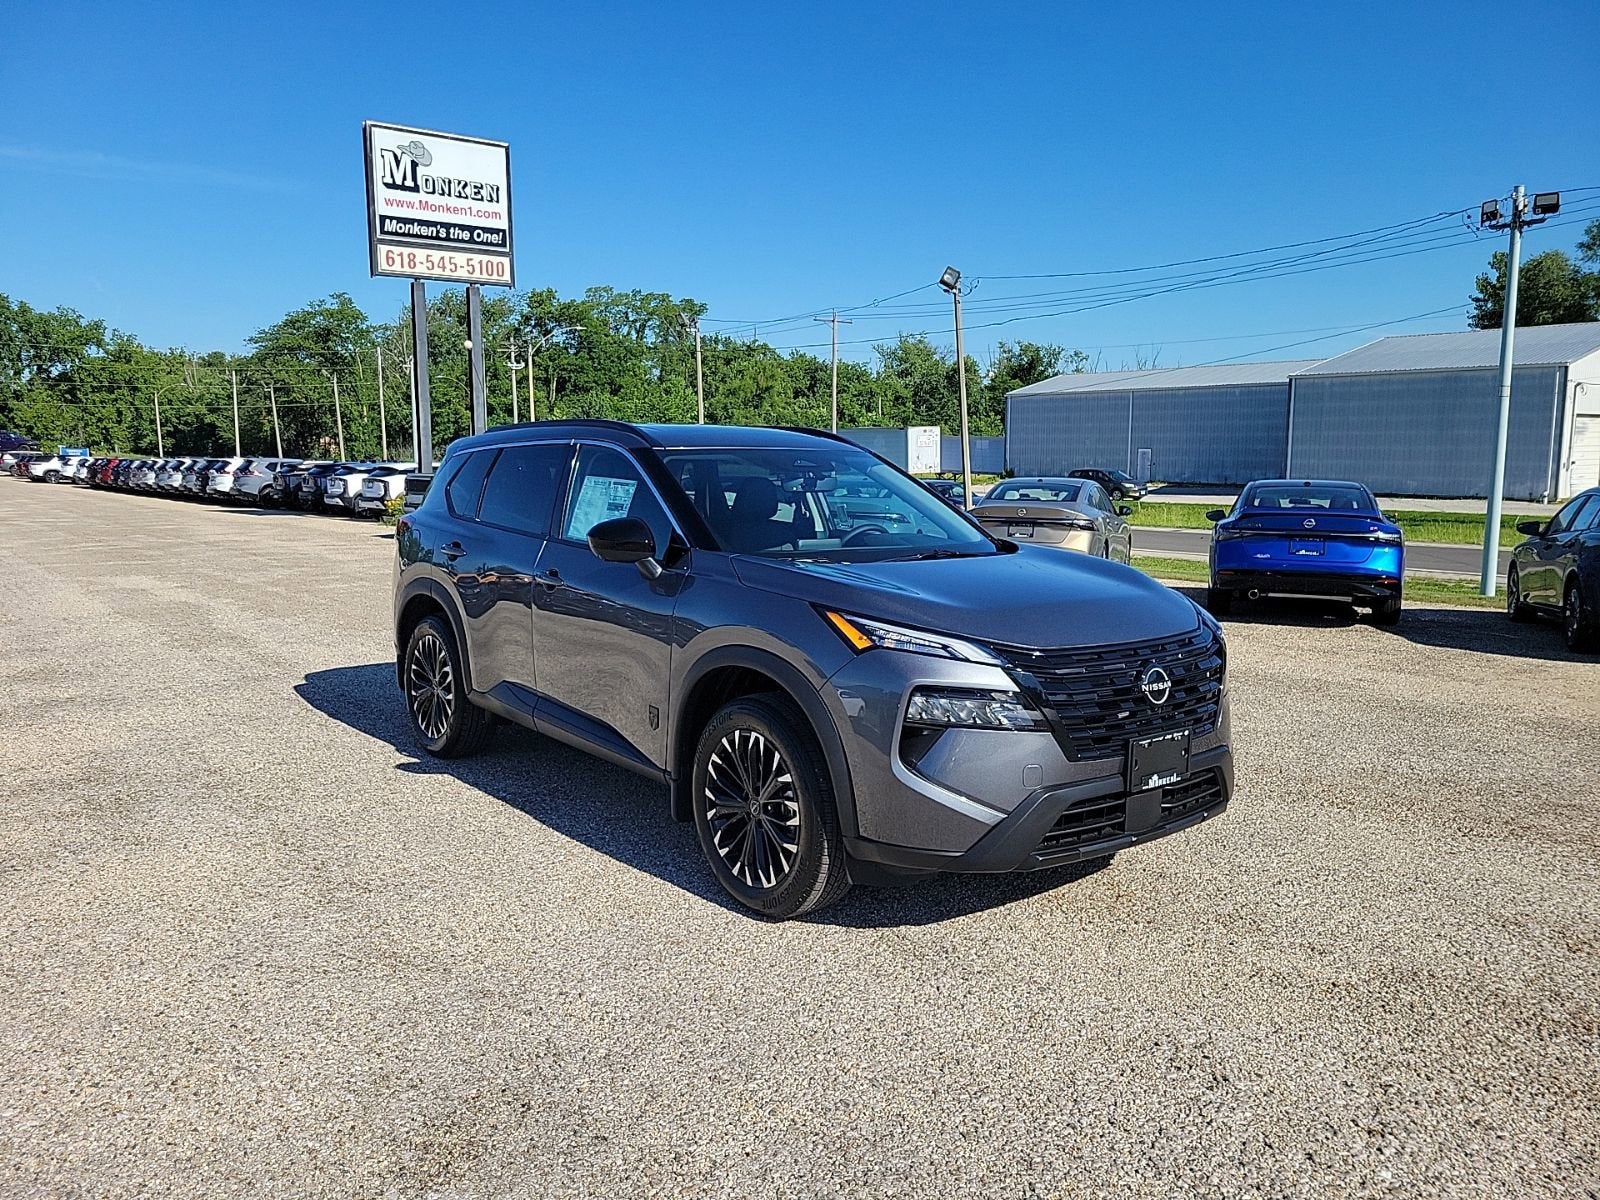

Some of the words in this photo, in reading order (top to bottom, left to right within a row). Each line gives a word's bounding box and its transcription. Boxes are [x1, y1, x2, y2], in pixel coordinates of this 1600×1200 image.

[380, 148, 500, 204] MONKEN
[384, 197, 501, 220] www.Monken1.com
[384, 219, 447, 239] Monken's
[450, 227, 470, 241] the
[473, 230, 503, 244] One!
[385, 249, 505, 278] 618-545-5100
[1141, 680, 1171, 692] NISSAN
